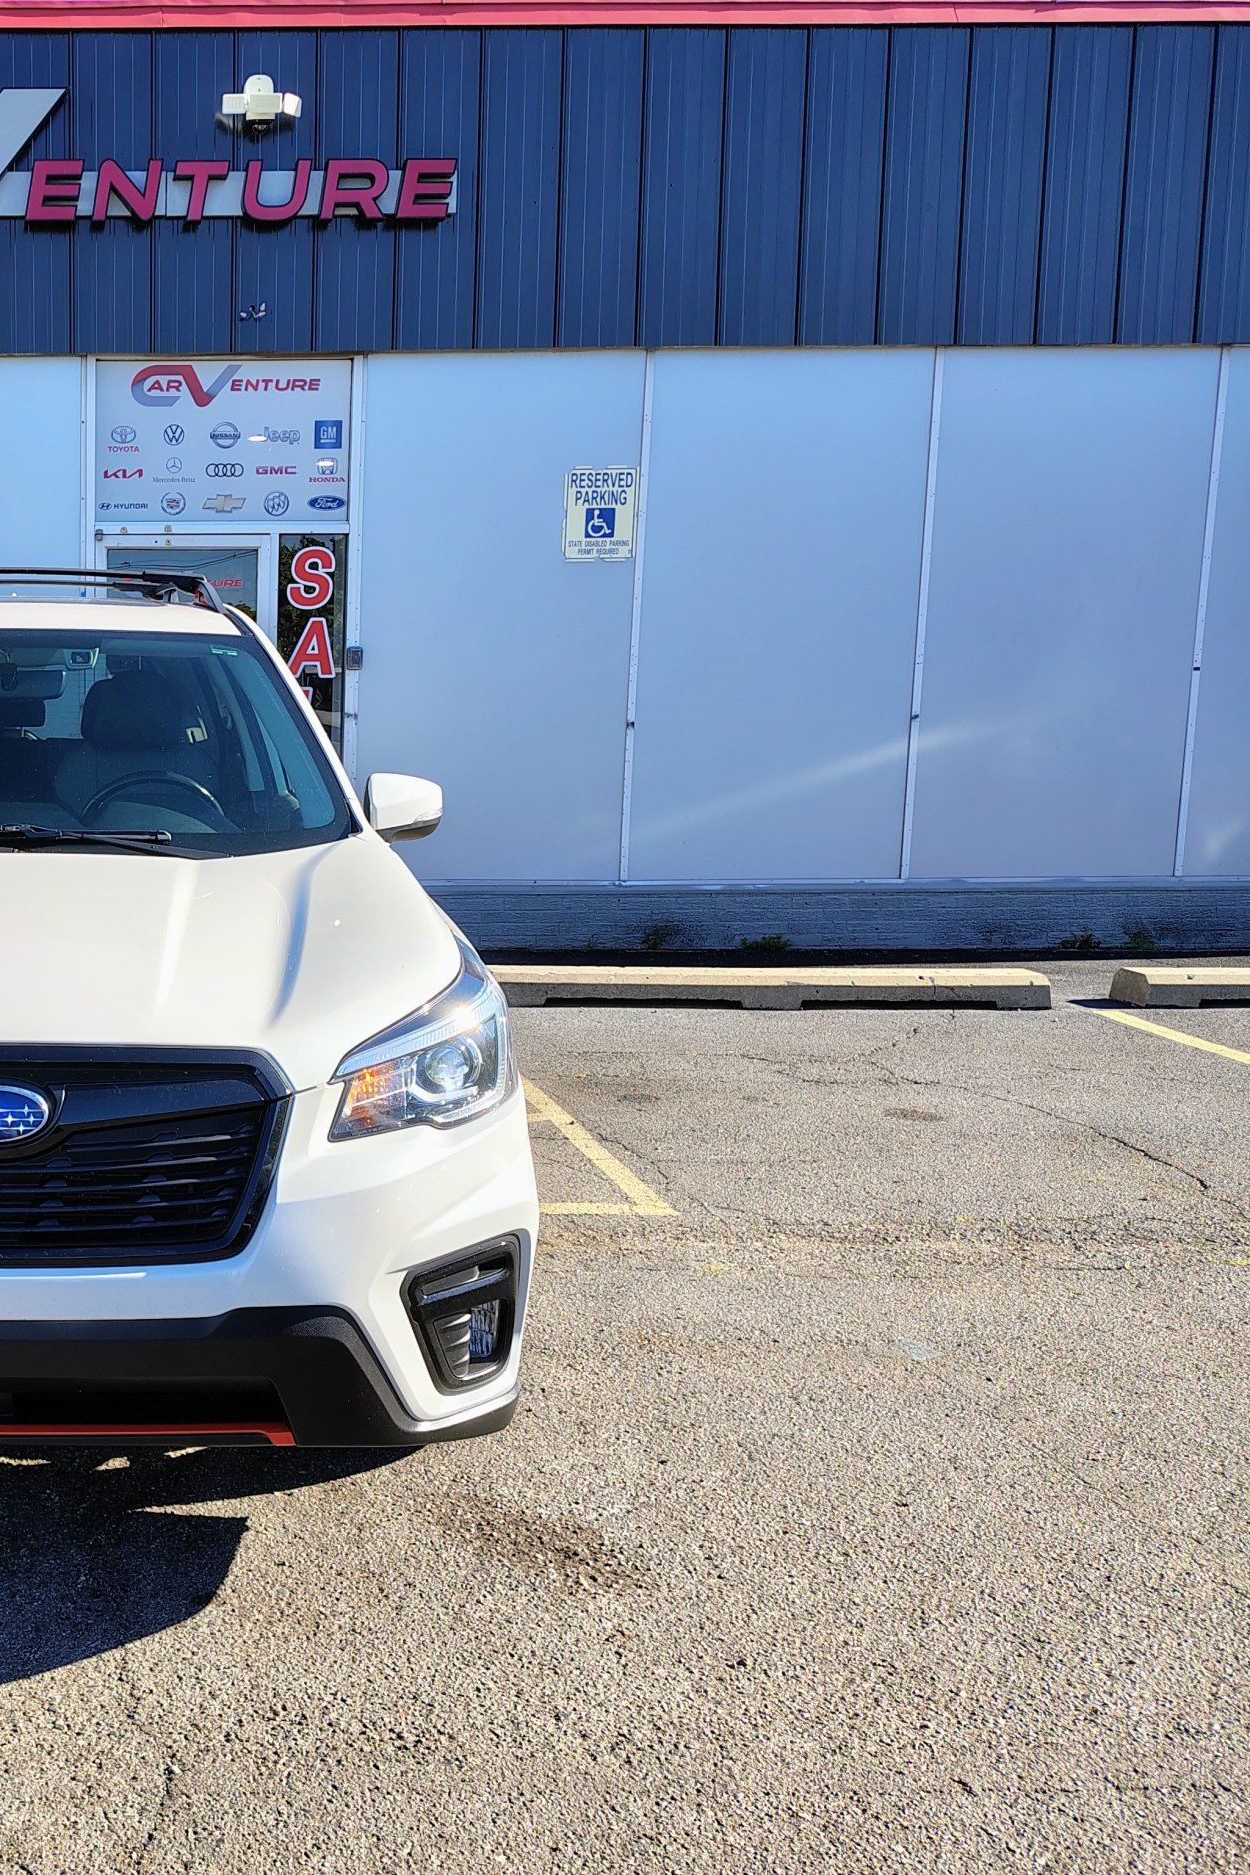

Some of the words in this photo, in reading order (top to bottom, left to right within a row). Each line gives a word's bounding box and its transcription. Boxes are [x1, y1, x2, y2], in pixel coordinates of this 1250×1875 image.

[211, 432, 240, 440] NISSAN
[262, 427, 300, 444] Jeep
[319, 425, 337, 440] GM
[103, 468, 144, 479] KIA
[255, 465, 297, 475] GMC
[570, 472, 634, 489] RESERVED
[575, 489, 628, 506] PARKING
[314, 499, 339, 509] Ford
[568, 540, 583, 548] STATE
[584, 540, 608, 548] DISABLED
[577, 548, 594, 556] PERMIT
[286, 546, 336, 704] SA
